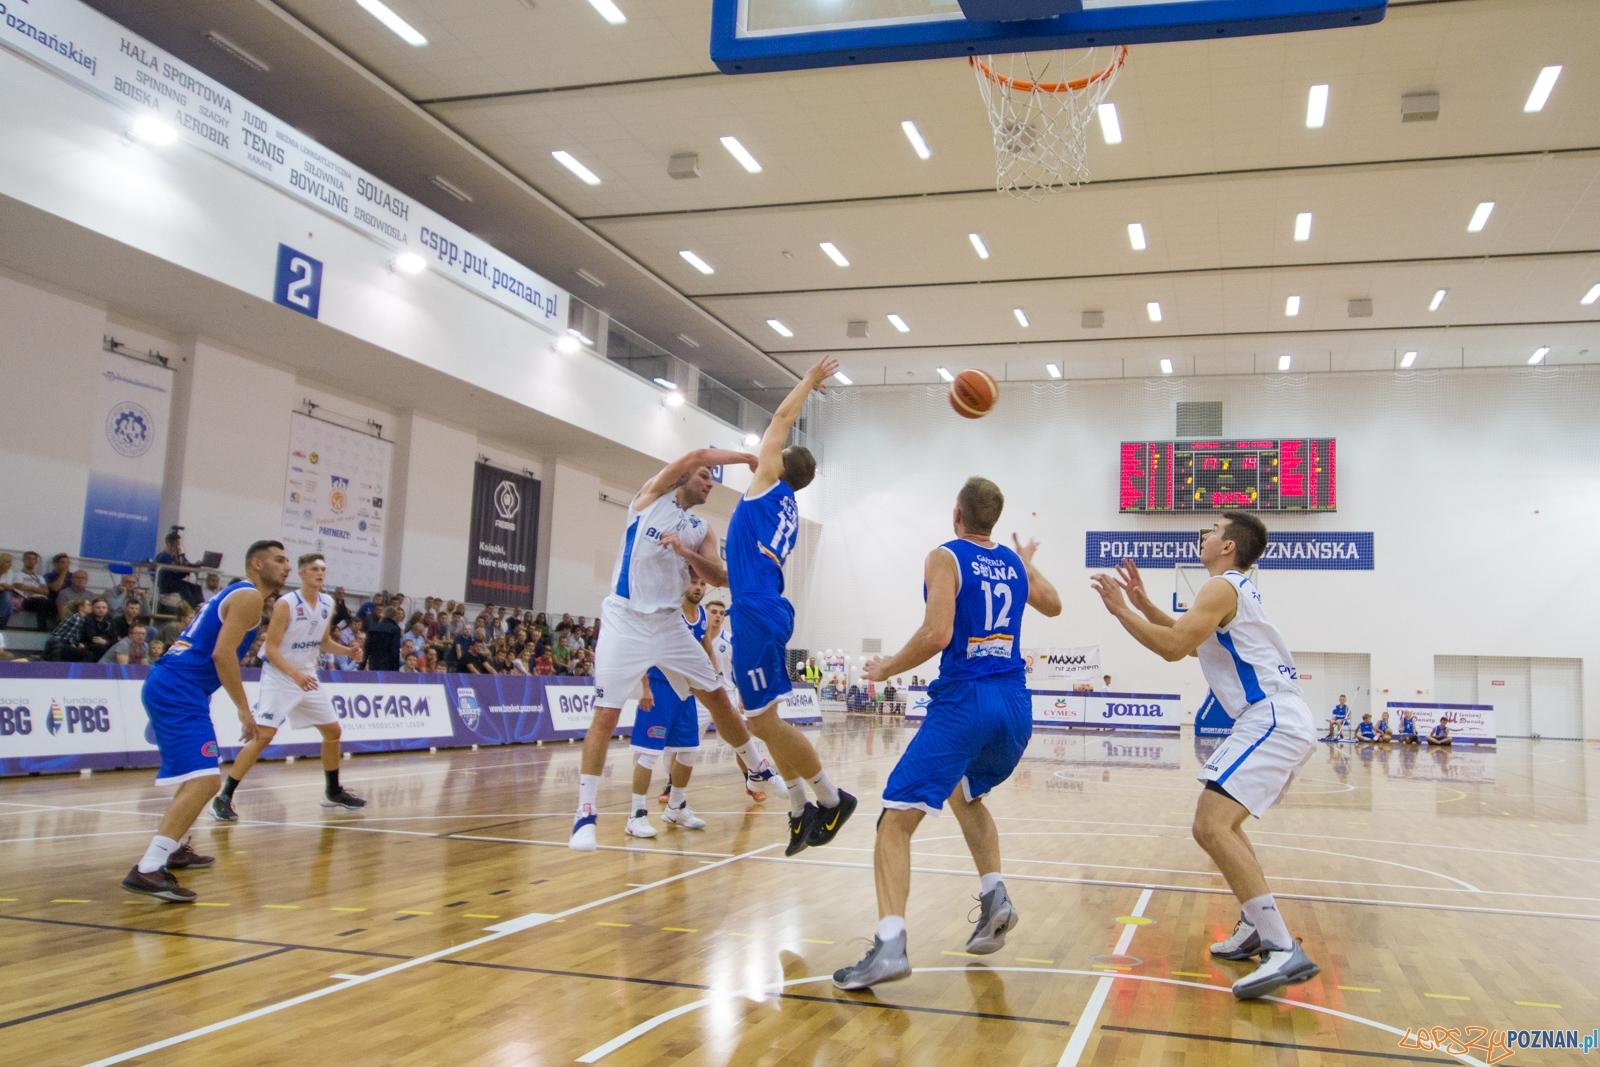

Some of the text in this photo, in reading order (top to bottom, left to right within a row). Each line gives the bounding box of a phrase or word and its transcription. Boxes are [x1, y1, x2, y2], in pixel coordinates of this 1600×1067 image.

[120, 37, 232, 114] HALA SPORTOWA
[135, 69, 187, 107] SPININNG
[113, 76, 160, 112] BOISKA
[174, 109, 229, 149] AEROBIK
[198, 105, 230, 128] SZACHY
[242, 110, 268, 133] JUDO
[241, 126, 285, 165] TENIS
[247, 152, 273, 172] KARATE
[303, 160, 344, 192] SIŁOWNIA
[289, 168, 349, 213] BOWLING
[356, 177, 410, 221] SQUASH
[287, 256, 313, 309] 2
[420, 226, 558, 318] cspp.put.poznan.pl
[1243, 457, 1257, 470] 14
[1100, 539, 1360, 559] POLITECHN ZNAŃSKA
[478, 556, 497, 568] które
[508, 562, 526, 574] czyta
[981, 580, 1013, 631] 12
[308, 620, 318, 636] 7
[747, 667, 768, 691] 11
[63, 697, 107, 705] fundacja
[331, 694, 430, 719] BIOFARM
[559, 694, 596, 713] BIOFA
[65, 705, 110, 733] PBG
